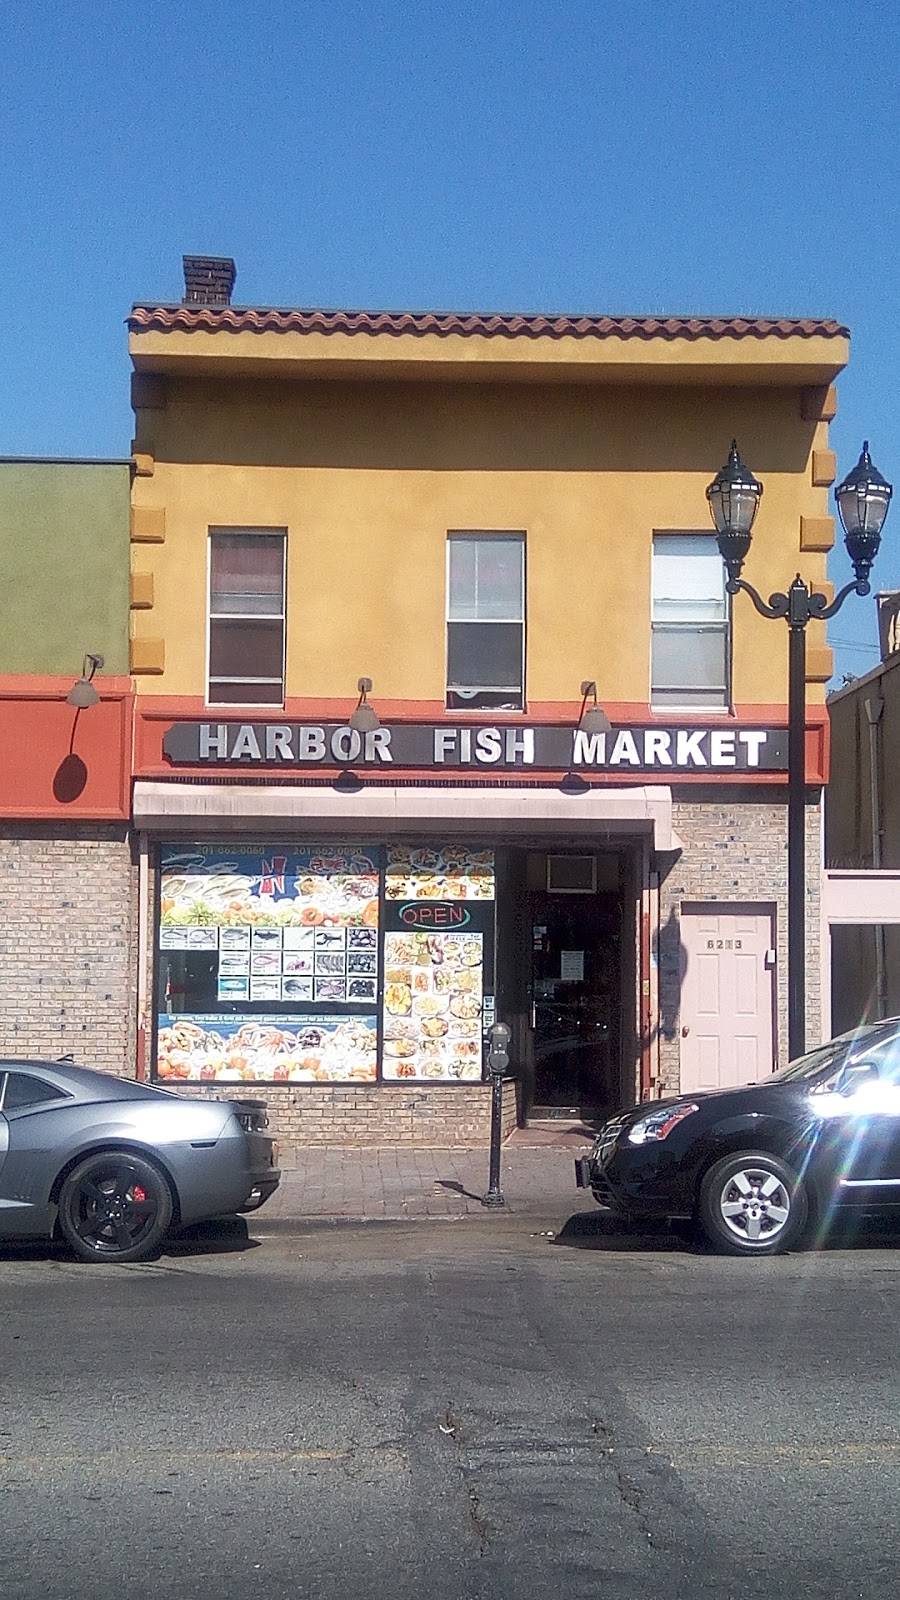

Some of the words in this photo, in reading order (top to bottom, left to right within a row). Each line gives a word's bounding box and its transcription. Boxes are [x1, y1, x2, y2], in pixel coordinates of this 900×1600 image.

[199, 724, 393, 762] HARBOR
[433, 727, 535, 764] FISH
[573, 729, 767, 767] MARKET
[402, 907, 463, 924] OPEN
[707, 939, 742, 950] 6213
